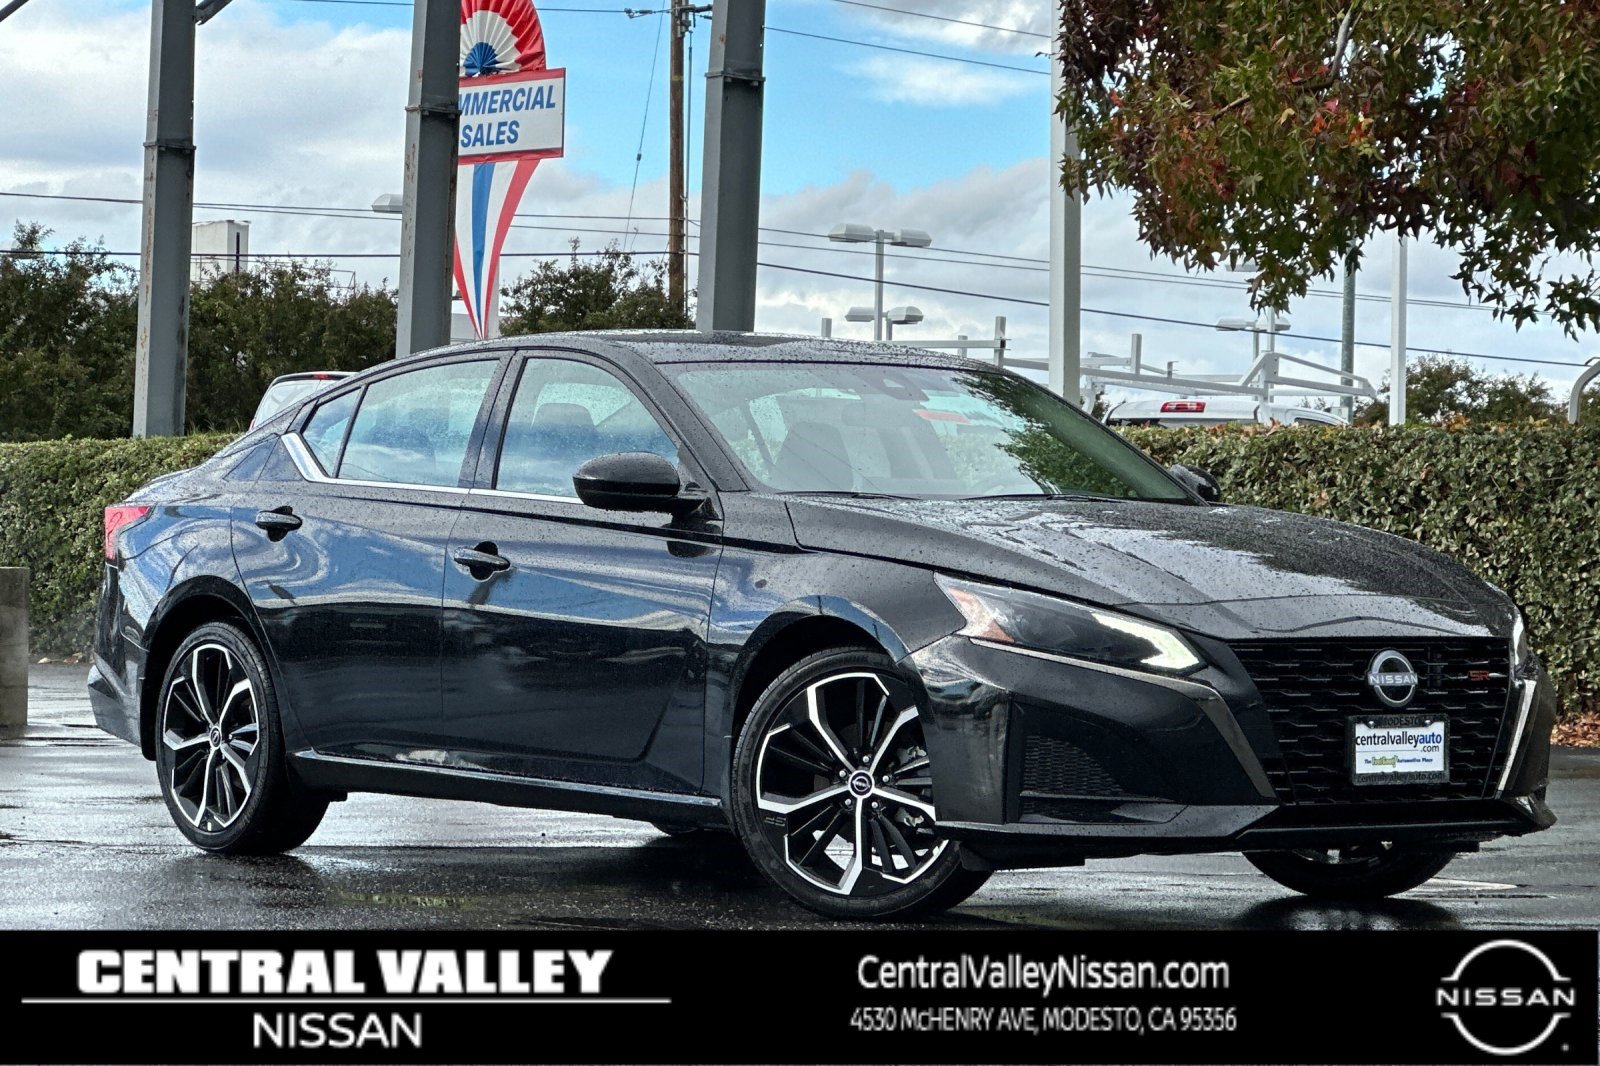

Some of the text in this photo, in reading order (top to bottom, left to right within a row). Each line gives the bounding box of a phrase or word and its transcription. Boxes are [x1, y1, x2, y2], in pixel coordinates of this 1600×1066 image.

[459, 85, 556, 116] MMERCIAL
[460, 120, 520, 148] SALES
[1369, 674, 1418, 685] NISSAN
